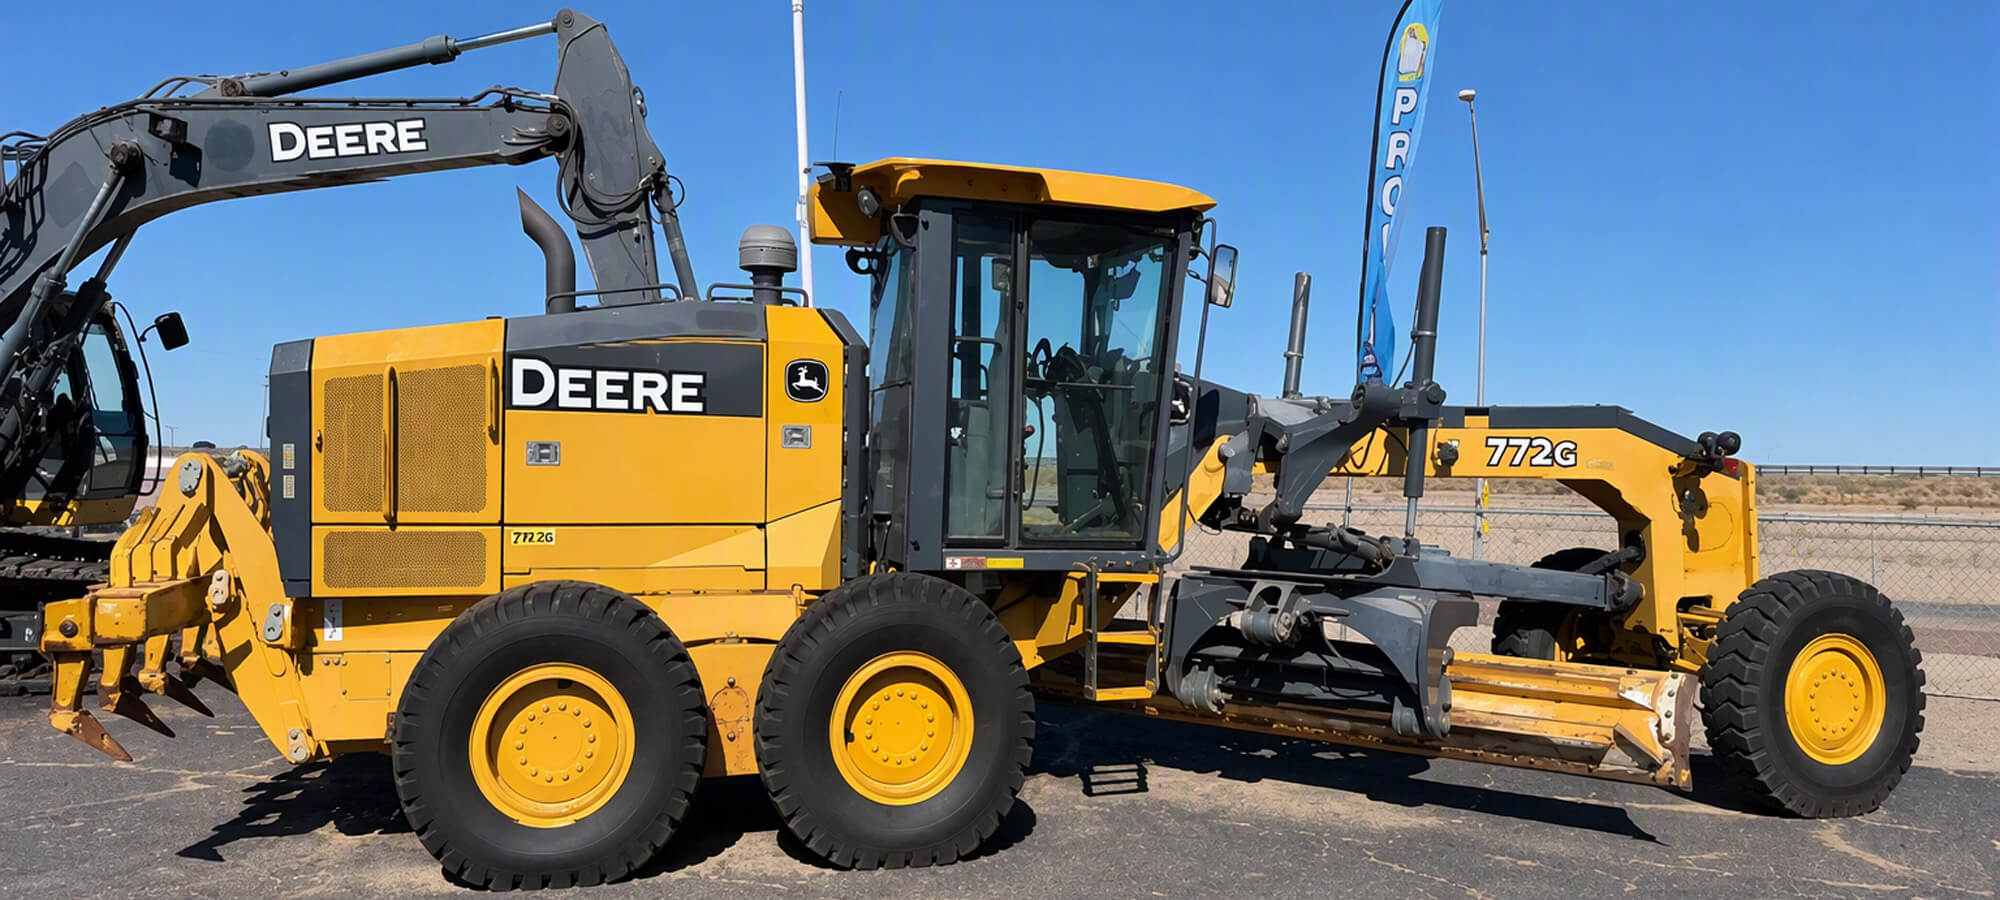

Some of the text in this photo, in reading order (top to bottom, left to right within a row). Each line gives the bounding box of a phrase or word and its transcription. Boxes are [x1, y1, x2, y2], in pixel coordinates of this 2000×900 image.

[268, 118, 428, 162] DEERE
[511, 357, 705, 412] DEERE
[1486, 436, 1577, 467] 772G
